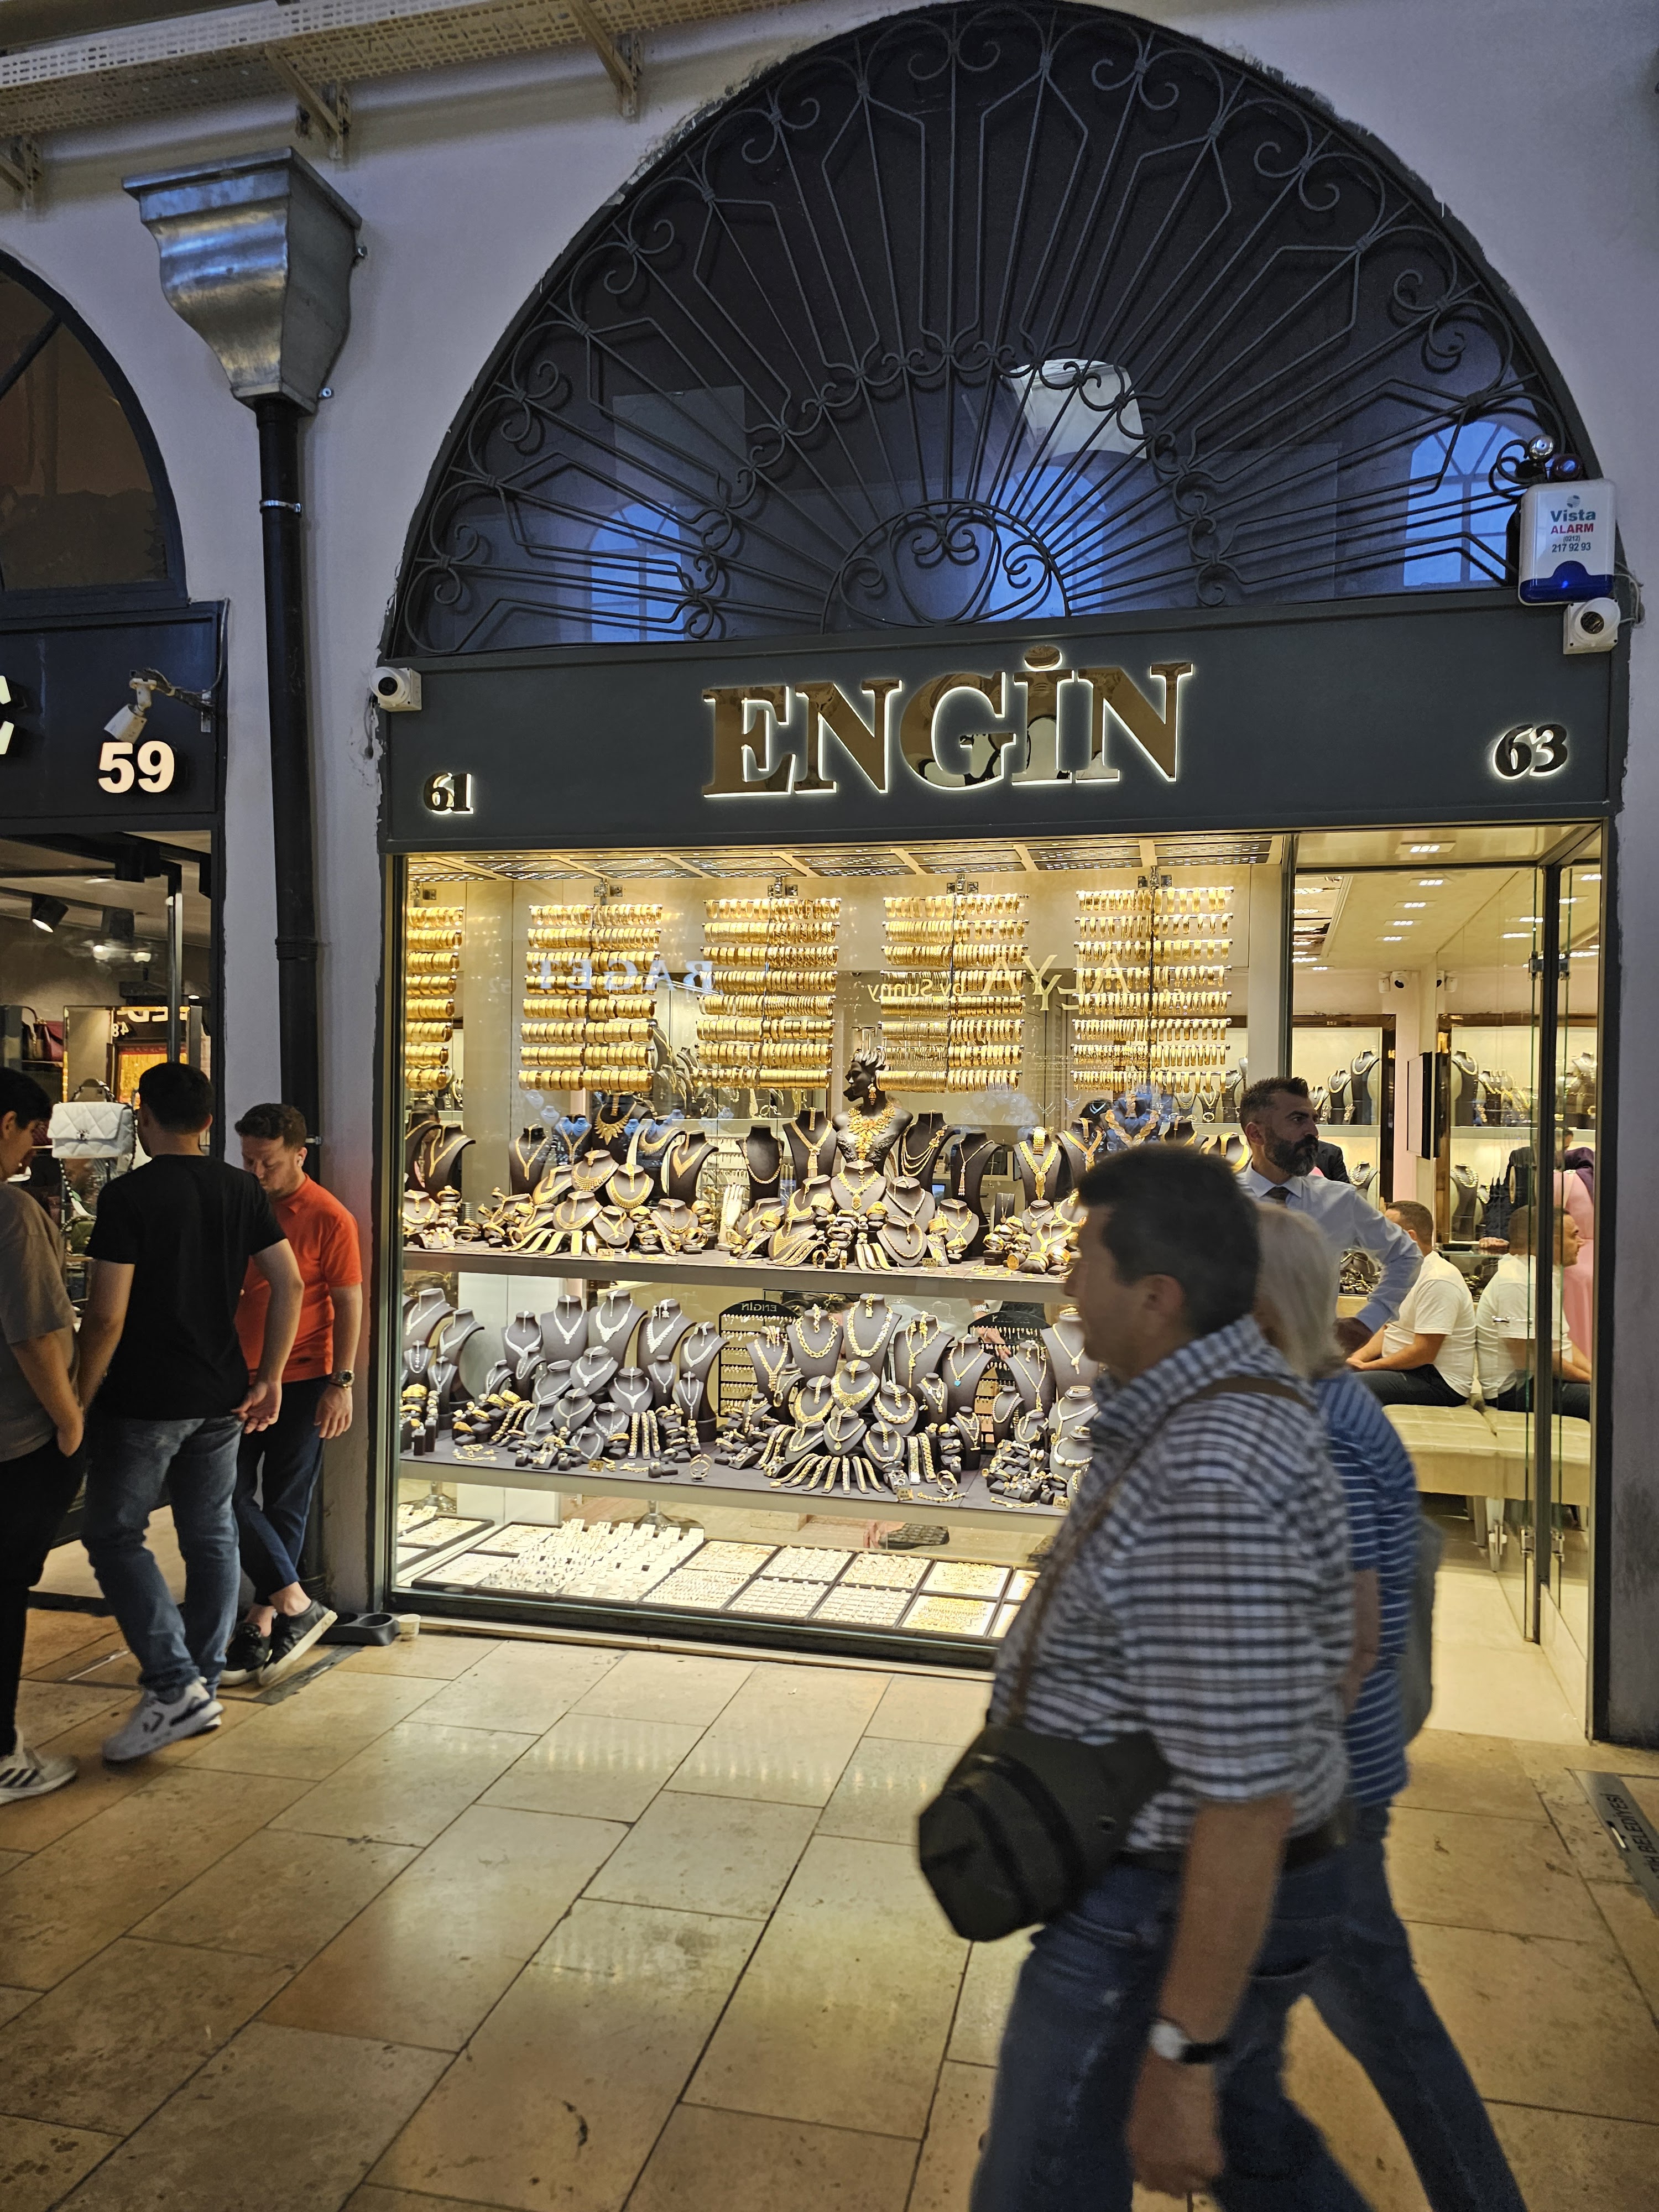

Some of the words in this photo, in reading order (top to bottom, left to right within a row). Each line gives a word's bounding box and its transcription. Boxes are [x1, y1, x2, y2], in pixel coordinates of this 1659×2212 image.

[1550, 509, 1596, 523] Vista
[1551, 523, 1594, 535] ALARM
[1552, 544, 1567, 553] 217
[1569, 542, 1579, 552] 92
[1581, 542, 1592, 551] 93
[1563, 535, 1581, 543] (0212)
[701, 645, 1194, 797] ENGİN
[1493, 724, 1568, 780] 63
[98, 740, 175, 793] 59
[424, 772, 474, 815] 61
